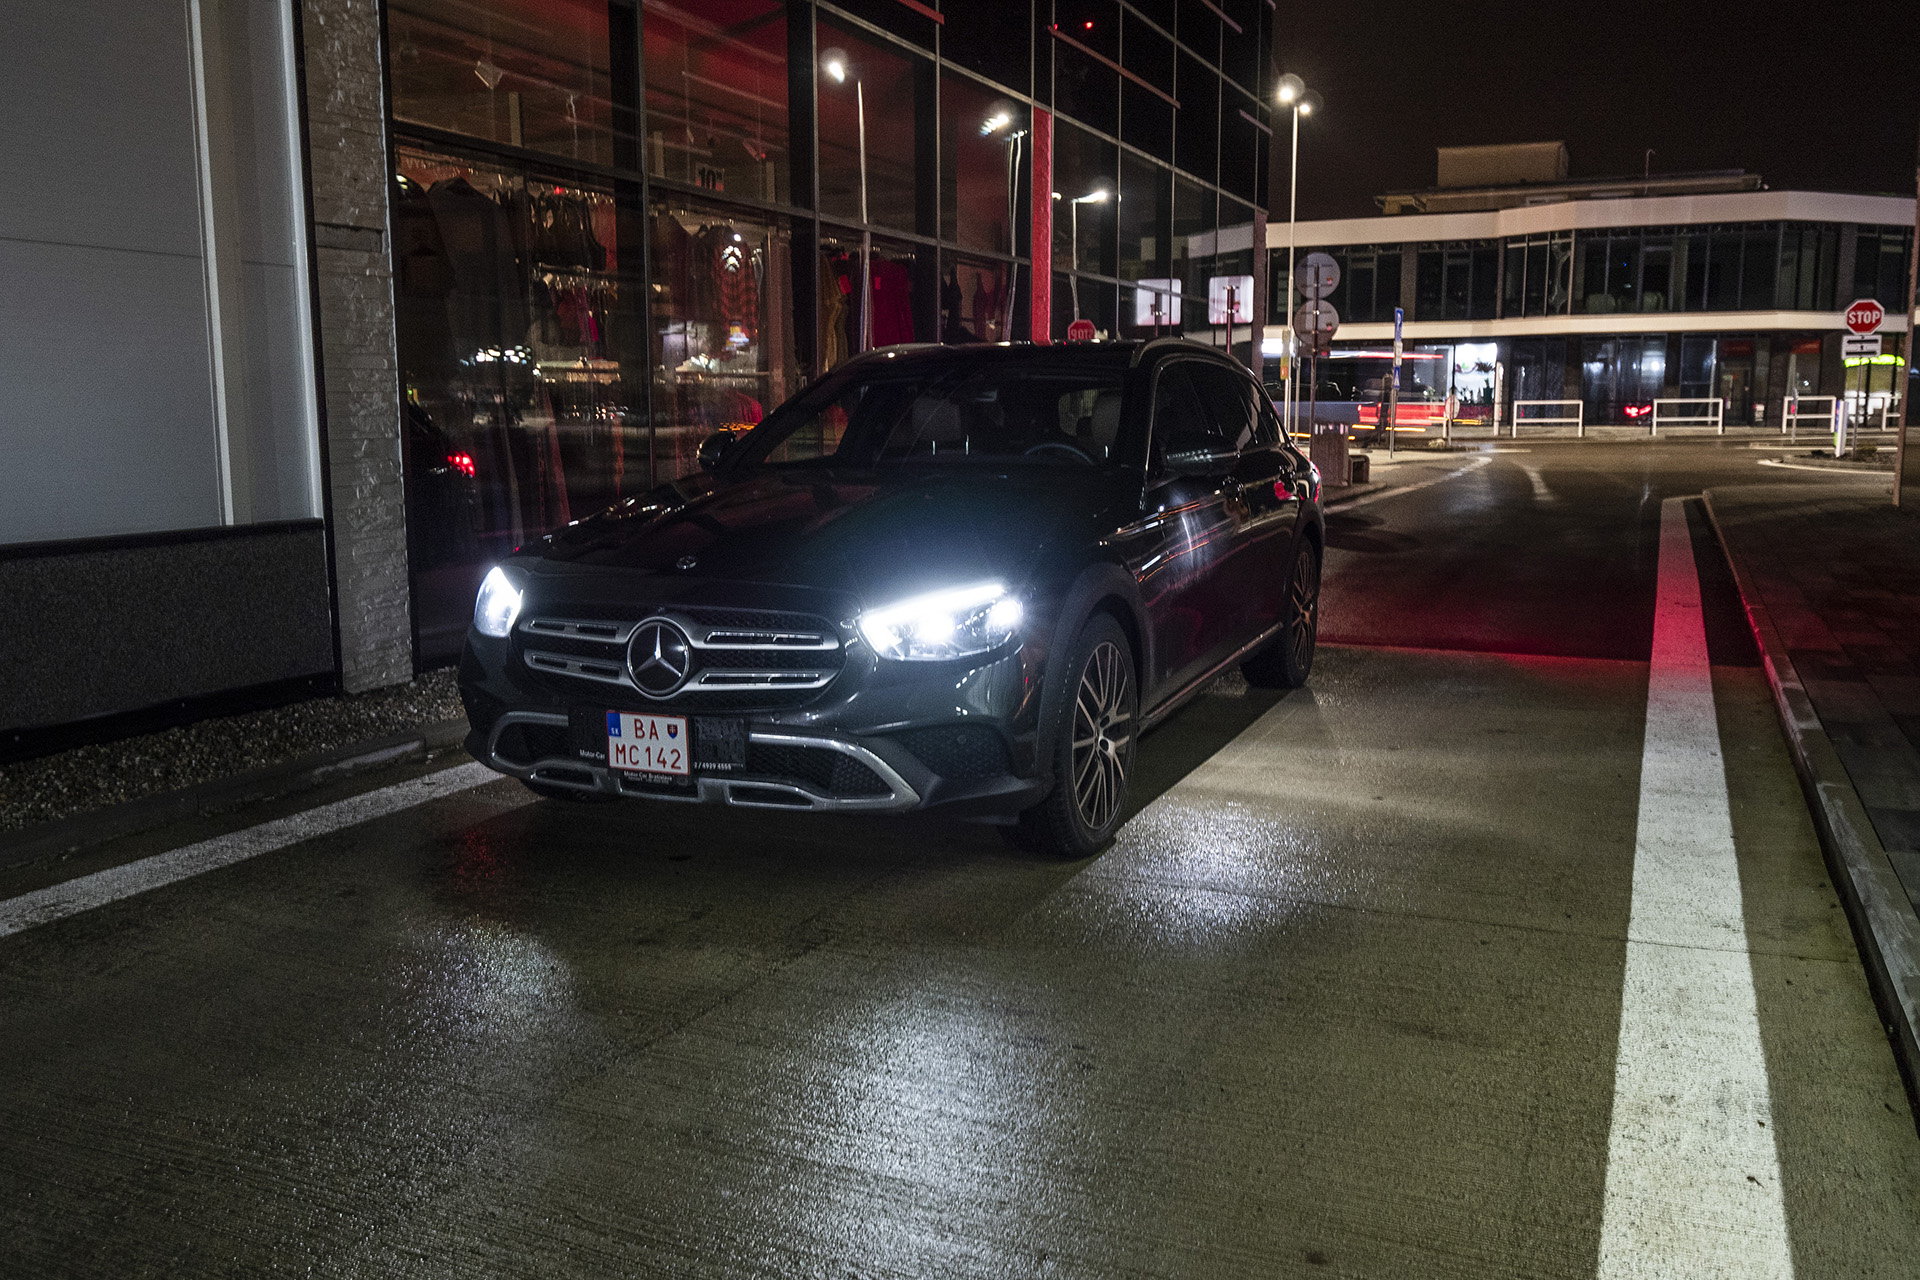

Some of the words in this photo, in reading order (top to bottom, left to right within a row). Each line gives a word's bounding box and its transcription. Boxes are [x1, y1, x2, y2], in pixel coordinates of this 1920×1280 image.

[1848, 310, 1880, 325] STOP
[610, 727, 620, 735] SK
[634, 718, 659, 741] BA
[616, 743, 681, 770] MC142
